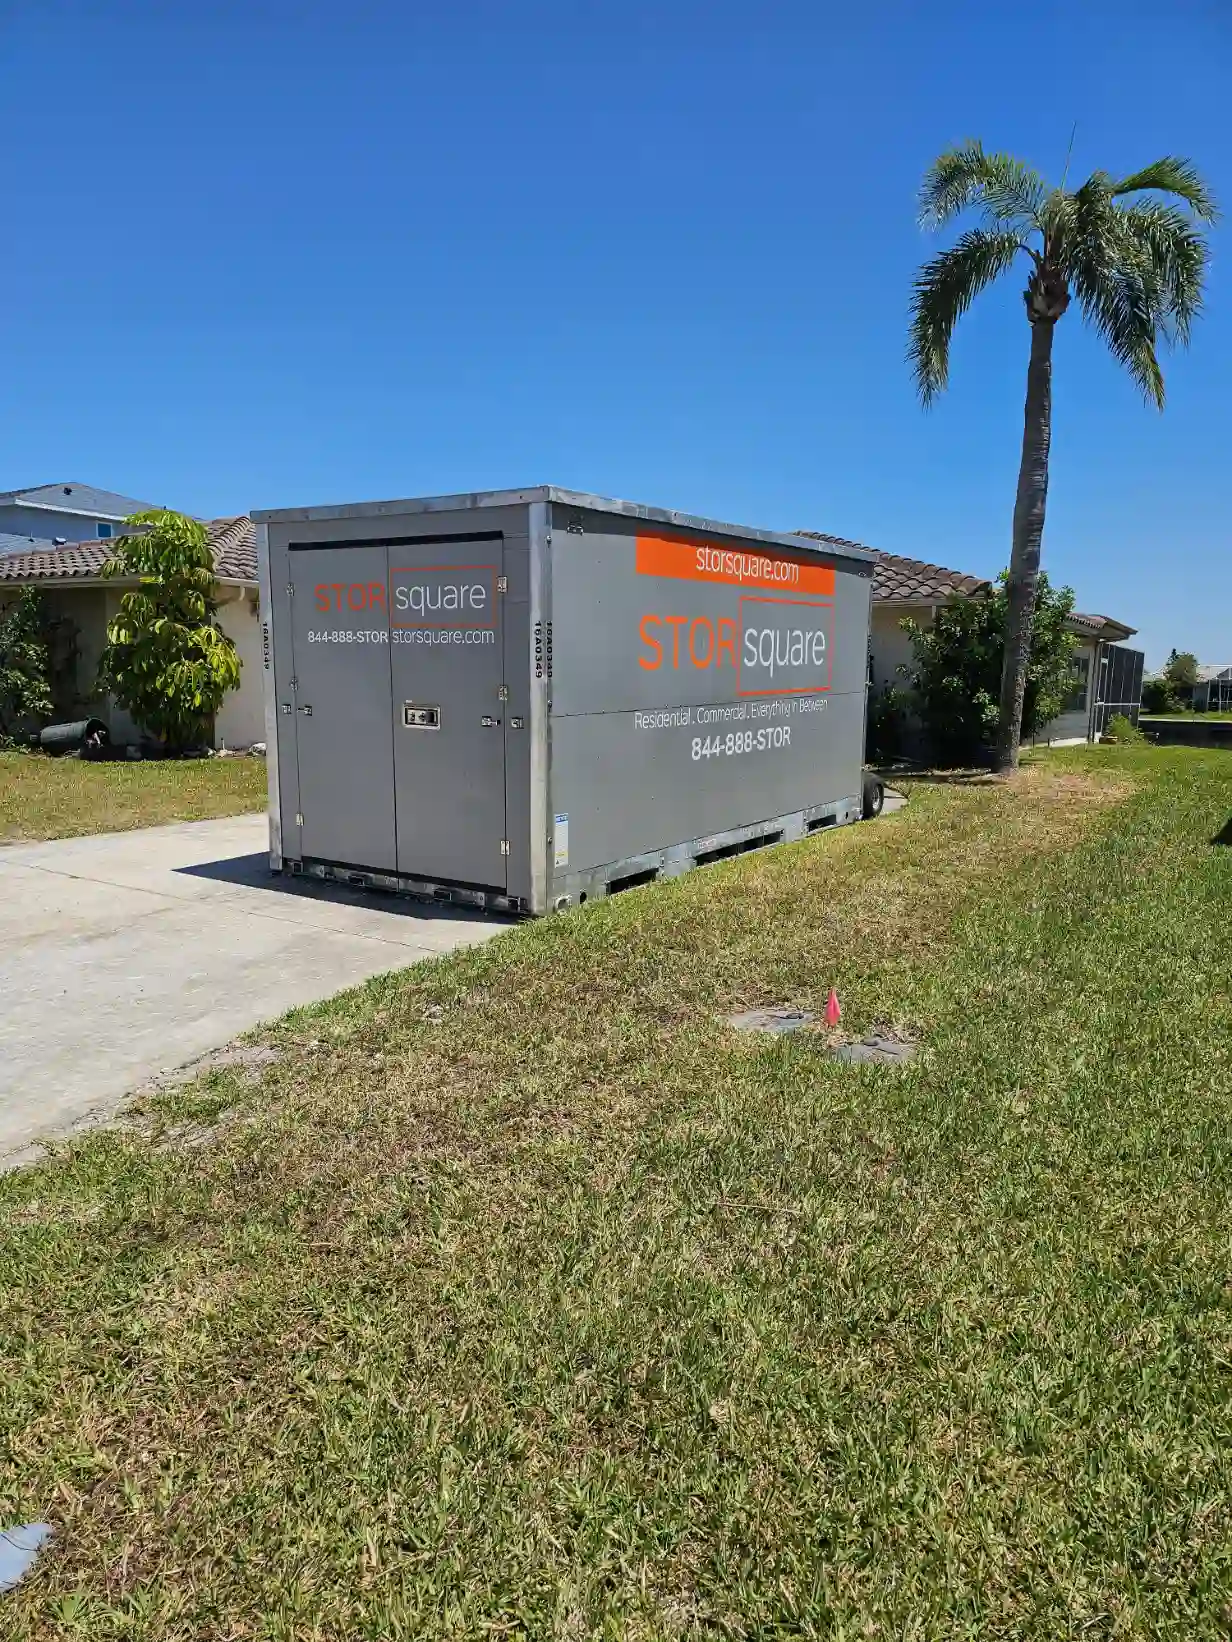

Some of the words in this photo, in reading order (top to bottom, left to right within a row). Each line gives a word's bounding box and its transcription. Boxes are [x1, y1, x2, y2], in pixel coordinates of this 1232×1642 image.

[695, 546, 799, 583] storsquare.com
[313, 583, 386, 614] STOR
[395, 584, 486, 616] square
[307, 630, 389, 645] 844-888-STOR
[392, 629, 495, 647] storsquare.com
[534, 620, 543, 678] 16A0349
[638, 614, 738, 670] STOR
[744, 628, 826, 678] square
[691, 726, 791, 761] 844-888-STOR
